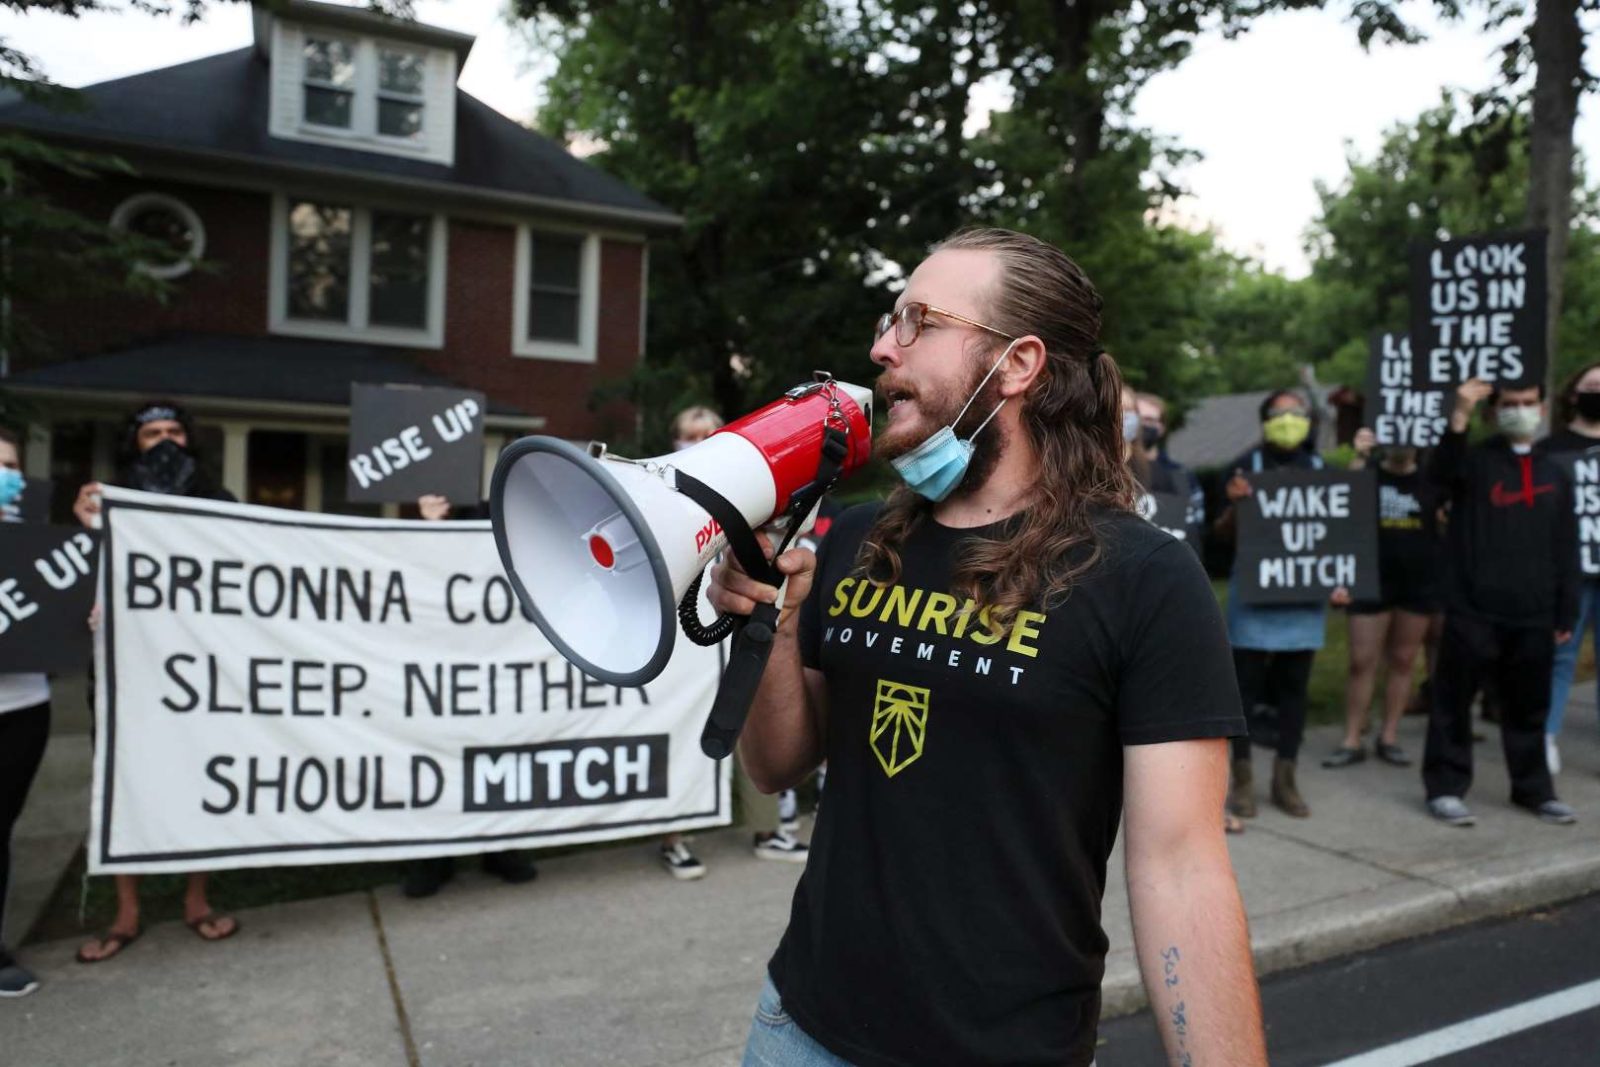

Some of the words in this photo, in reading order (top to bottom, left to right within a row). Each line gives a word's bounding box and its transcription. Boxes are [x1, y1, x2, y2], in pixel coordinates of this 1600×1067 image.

[1430, 243, 1527, 279] LOOK
[1431, 279, 1479, 314] US
[1487, 277, 1526, 309] IN
[1431, 312, 1514, 346] THE
[1430, 345, 1524, 382] EYES
[1380, 388, 1443, 418] THE
[349, 425, 432, 489] RISE
[431, 398, 479, 442] UP
[1257, 484, 1350, 518] WAKE
[1281, 522, 1327, 552] UP
[34, 532, 94, 590] UP
[1259, 555, 1356, 588] MITCH
[126, 552, 411, 623] BREONNA
[447, 572, 538, 624] CO
[828, 577, 1047, 658] SUNRISE
[161, 653, 372, 717] SLEEP.
[202, 754, 445, 815] SHOULD
[472, 744, 651, 804] MITCH
